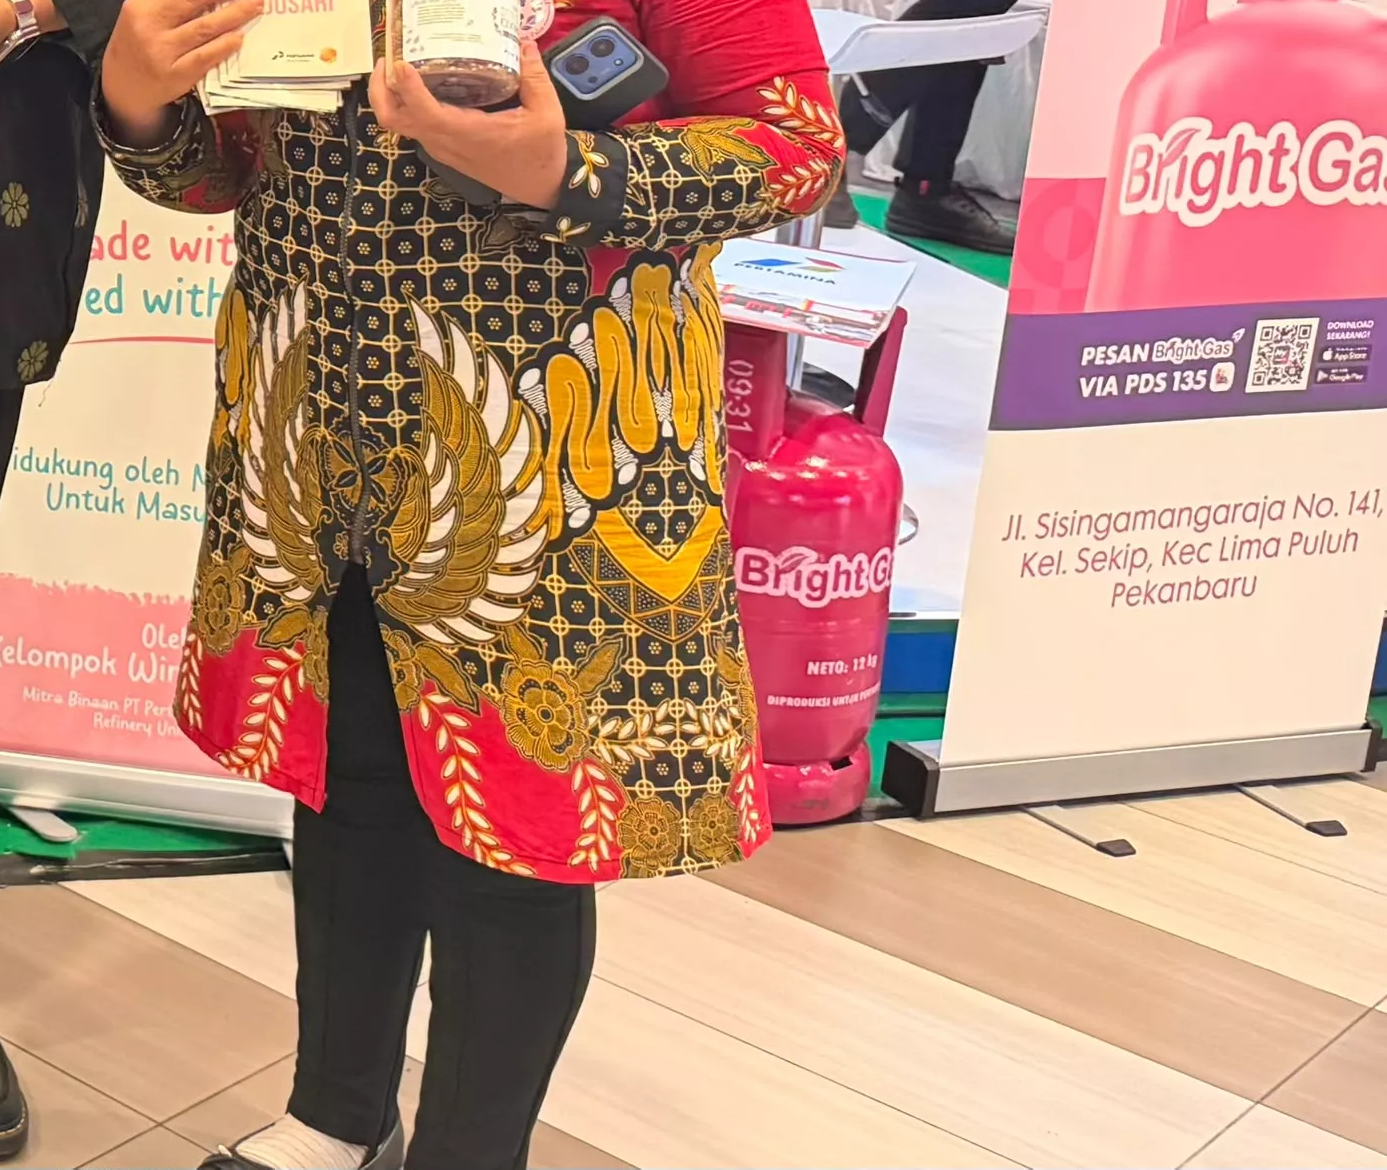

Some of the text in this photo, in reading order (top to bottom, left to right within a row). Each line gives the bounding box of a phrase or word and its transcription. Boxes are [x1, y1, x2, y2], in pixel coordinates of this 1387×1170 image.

[1124, 128, 1387, 215] Bright Ga
[90, 219, 235, 266] ade wit
[733, 262, 836, 285] PERTAMINA
[1327, 319, 1375, 330] DOWNLOAD
[1081, 338, 1233, 366] PESAN Bright Gas
[1079, 369, 1207, 397] VIA PDS 135
[13, 446, 114, 490] idukung
[125, 456, 180, 485] oleh
[46, 483, 125, 514] Untuk
[1002, 487, 1385, 543] Jl. Sisingamangaraja No. 141,
[1020, 527, 1359, 579] Kel. Sekip, Kec Lima Puluh
[740, 551, 866, 603] Bright
[1111, 573, 1258, 609] Pekanbaru
[128, 652, 181, 684] Wir
[806, 661, 849, 676] NETO:
[22, 686, 173, 718] Mitra Binaan PT Pert
[766, 695, 831, 708] DIPRODUKSI
[93, 712, 152, 737] Refinery
